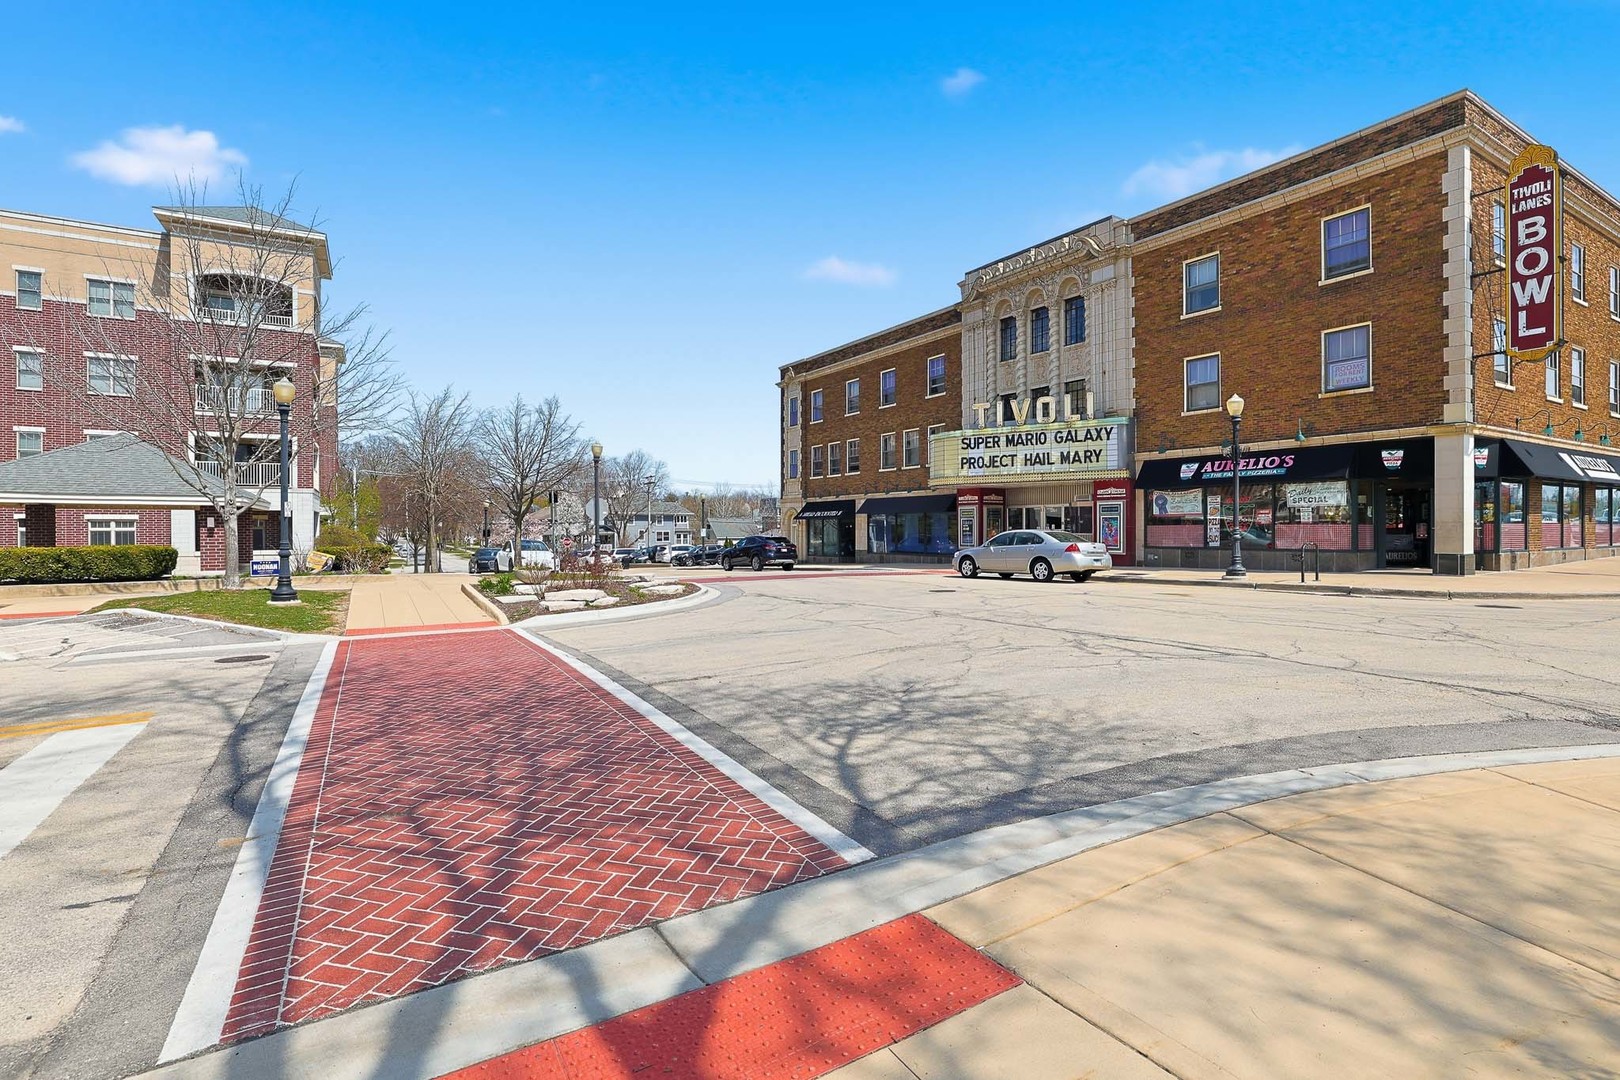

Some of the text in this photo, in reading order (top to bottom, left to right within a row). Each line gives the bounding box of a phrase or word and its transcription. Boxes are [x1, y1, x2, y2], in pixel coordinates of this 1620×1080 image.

[1511, 179, 1552, 200] TIVOLI
[1511, 193, 1552, 214] LANES
[1511, 215, 1553, 338] BOWL
[1335, 362, 1365, 373] ROOMS
[1349, 368, 1365, 376] RENT
[1335, 375, 1365, 384] WEEKLY
[972, 391, 1094, 430] TIVOLI
[961, 426, 1114, 450] SUPER MARIO GALAXY
[960, 448, 1103, 470] PROJECT HAIL MARY
[1292, 496, 1329, 504] SPECIAL
[253, 563, 277, 571] NOONAN
